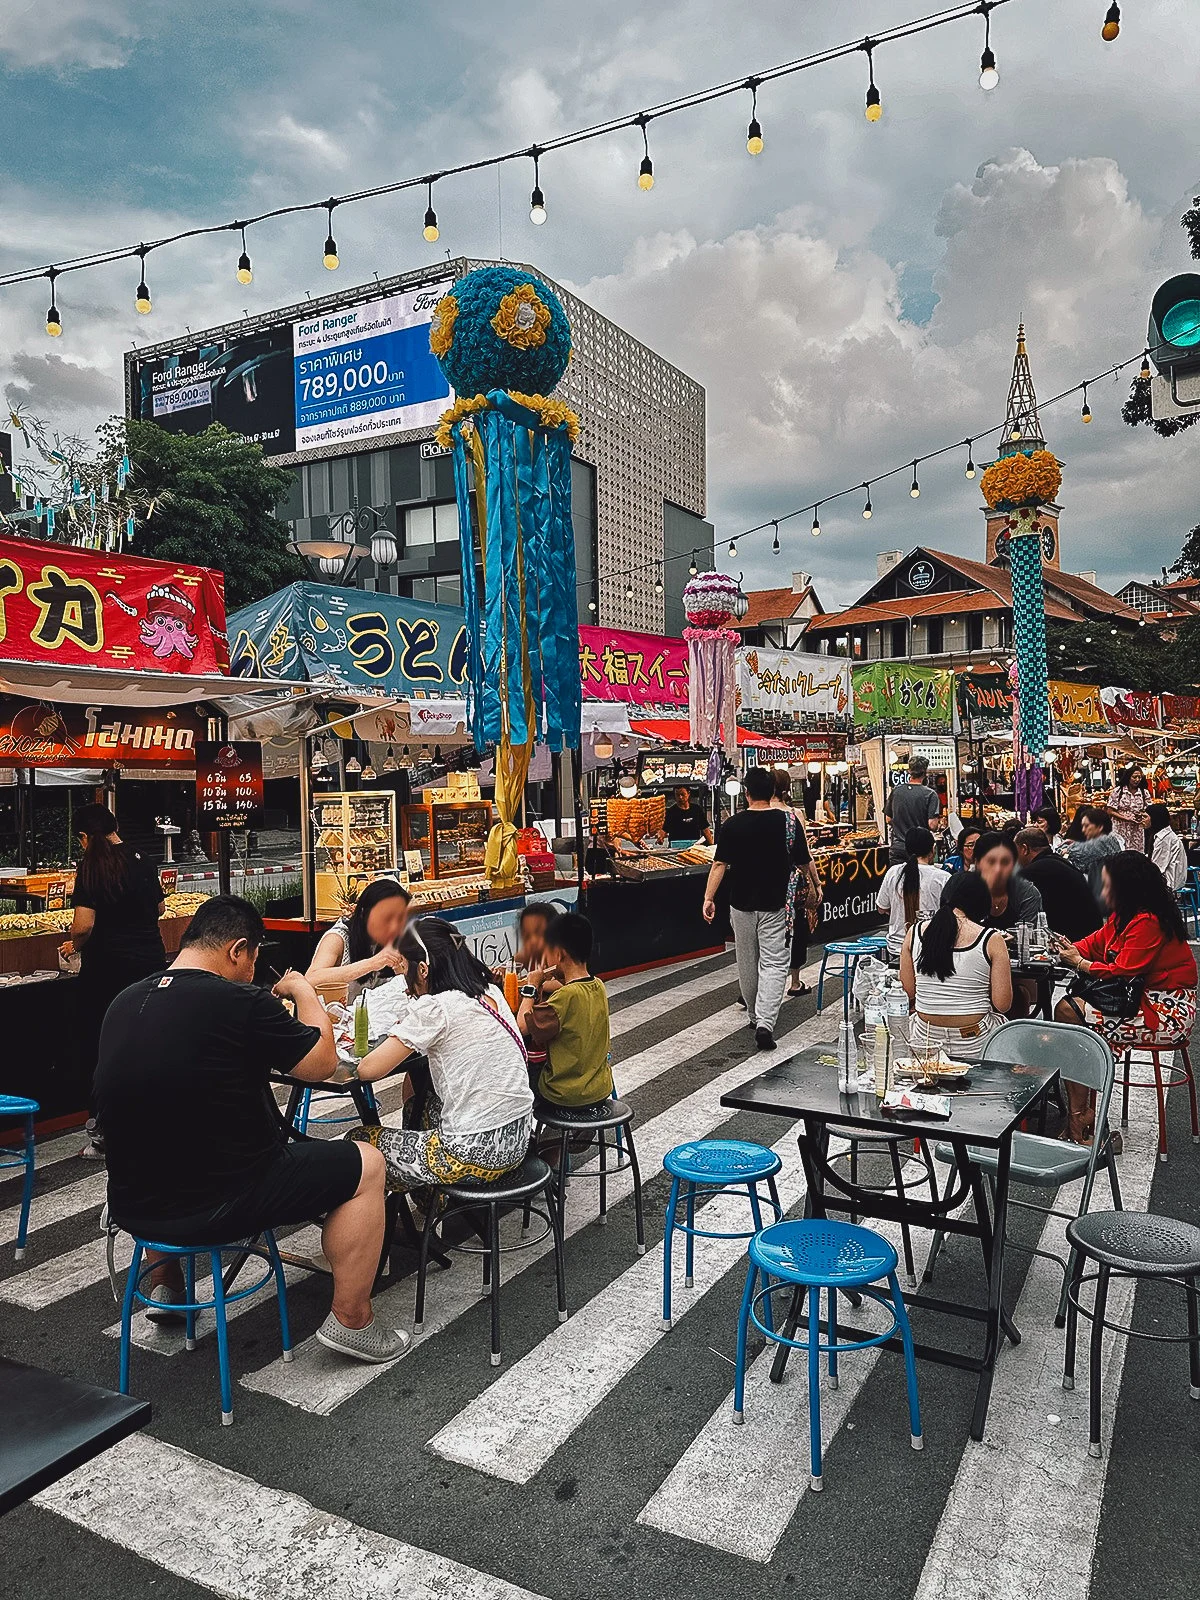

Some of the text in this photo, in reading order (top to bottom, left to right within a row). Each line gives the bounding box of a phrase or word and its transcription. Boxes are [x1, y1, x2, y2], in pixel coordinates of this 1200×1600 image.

[298, 313, 358, 337] Ford Ranger
[152, 361, 208, 384] Ford Ranger
[300, 348, 363, 375] ราคาพิเศษ
[299, 361, 405, 402] 789,000 บาท
[165, 388, 199, 406] 789,000
[349, 395, 387, 412] 889,000
[389, 393, 406, 404] บาท
[85, 706, 194, 750] โฮมเมด
[207, 773, 213, 784] 6
[202, 787, 214, 797] 10
[203, 800, 214, 811] 15
[822, 896, 851, 922] Beef
